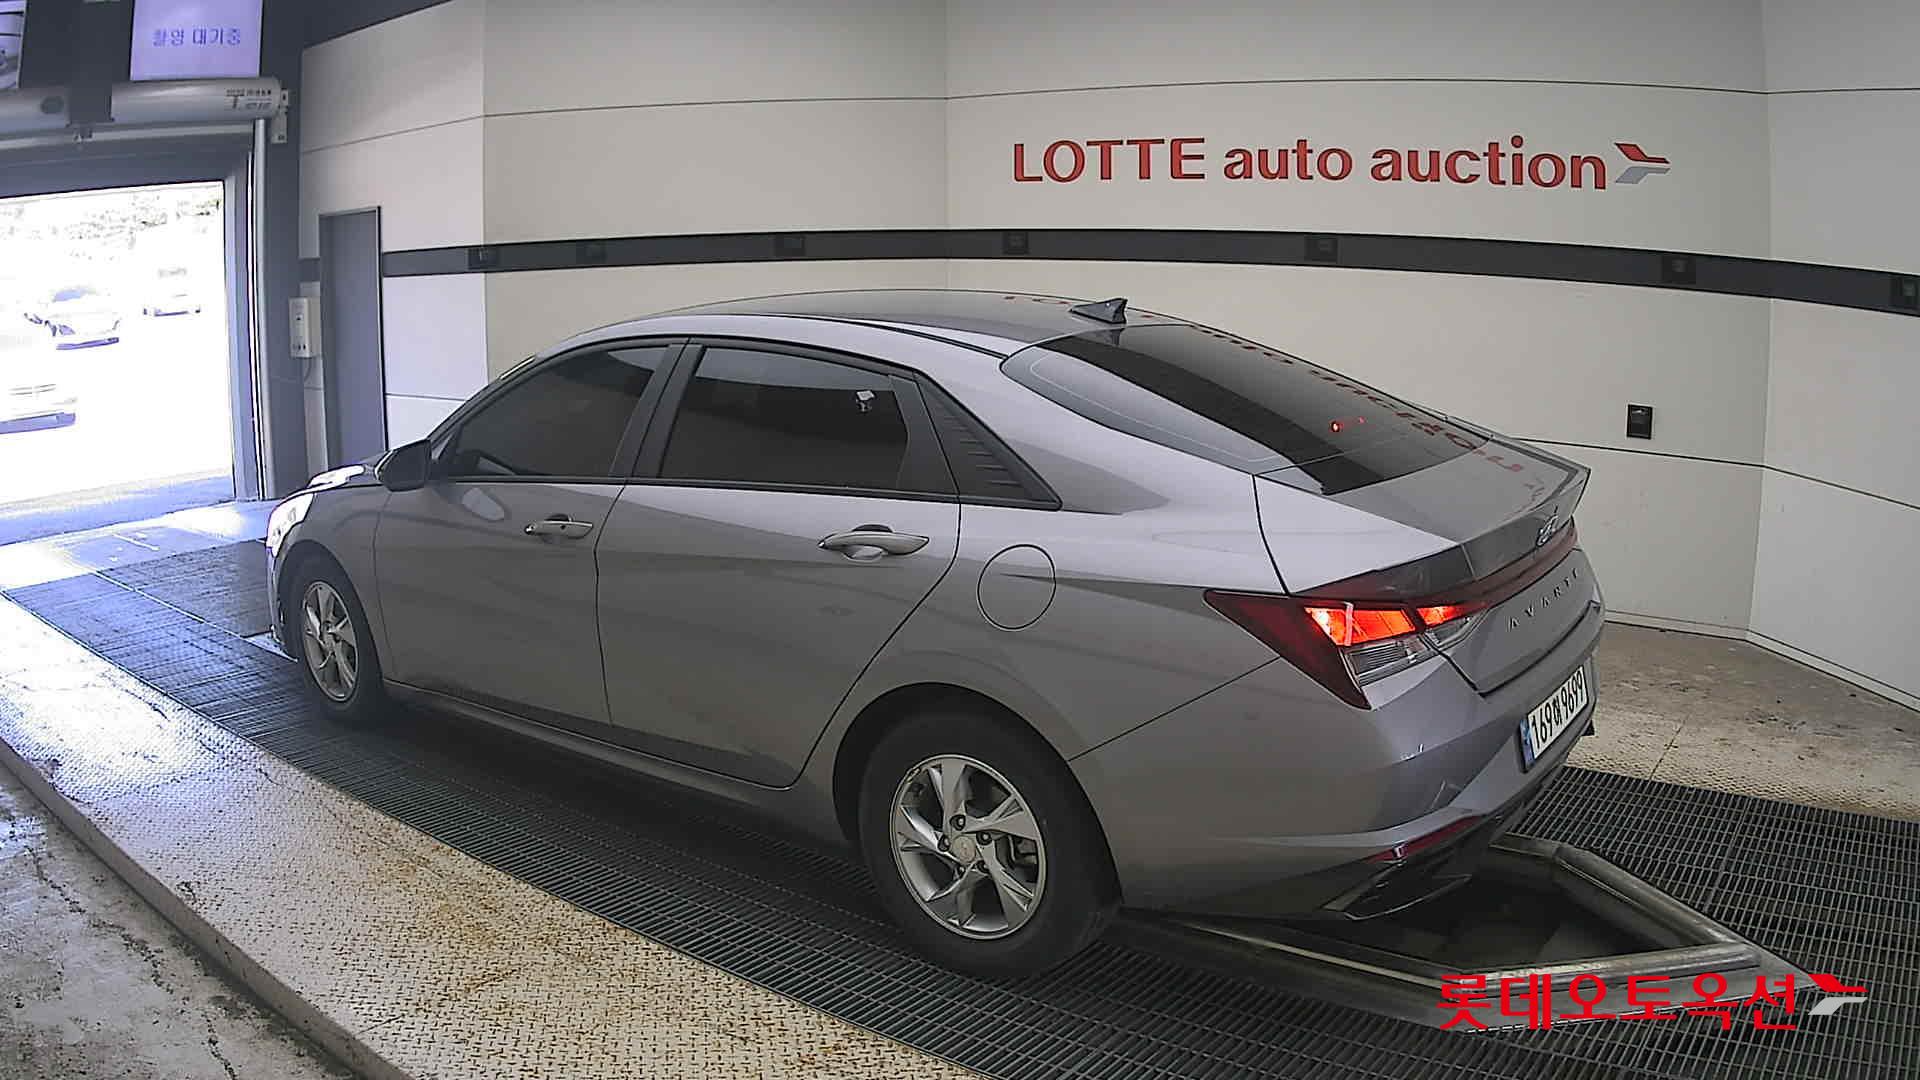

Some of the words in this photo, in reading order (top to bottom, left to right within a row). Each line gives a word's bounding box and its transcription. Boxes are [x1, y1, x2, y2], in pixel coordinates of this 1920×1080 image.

[1013, 137, 1206, 184] LOTTE
[1223, 138, 1354, 182] auto
[1371, 135, 1607, 190] auction
